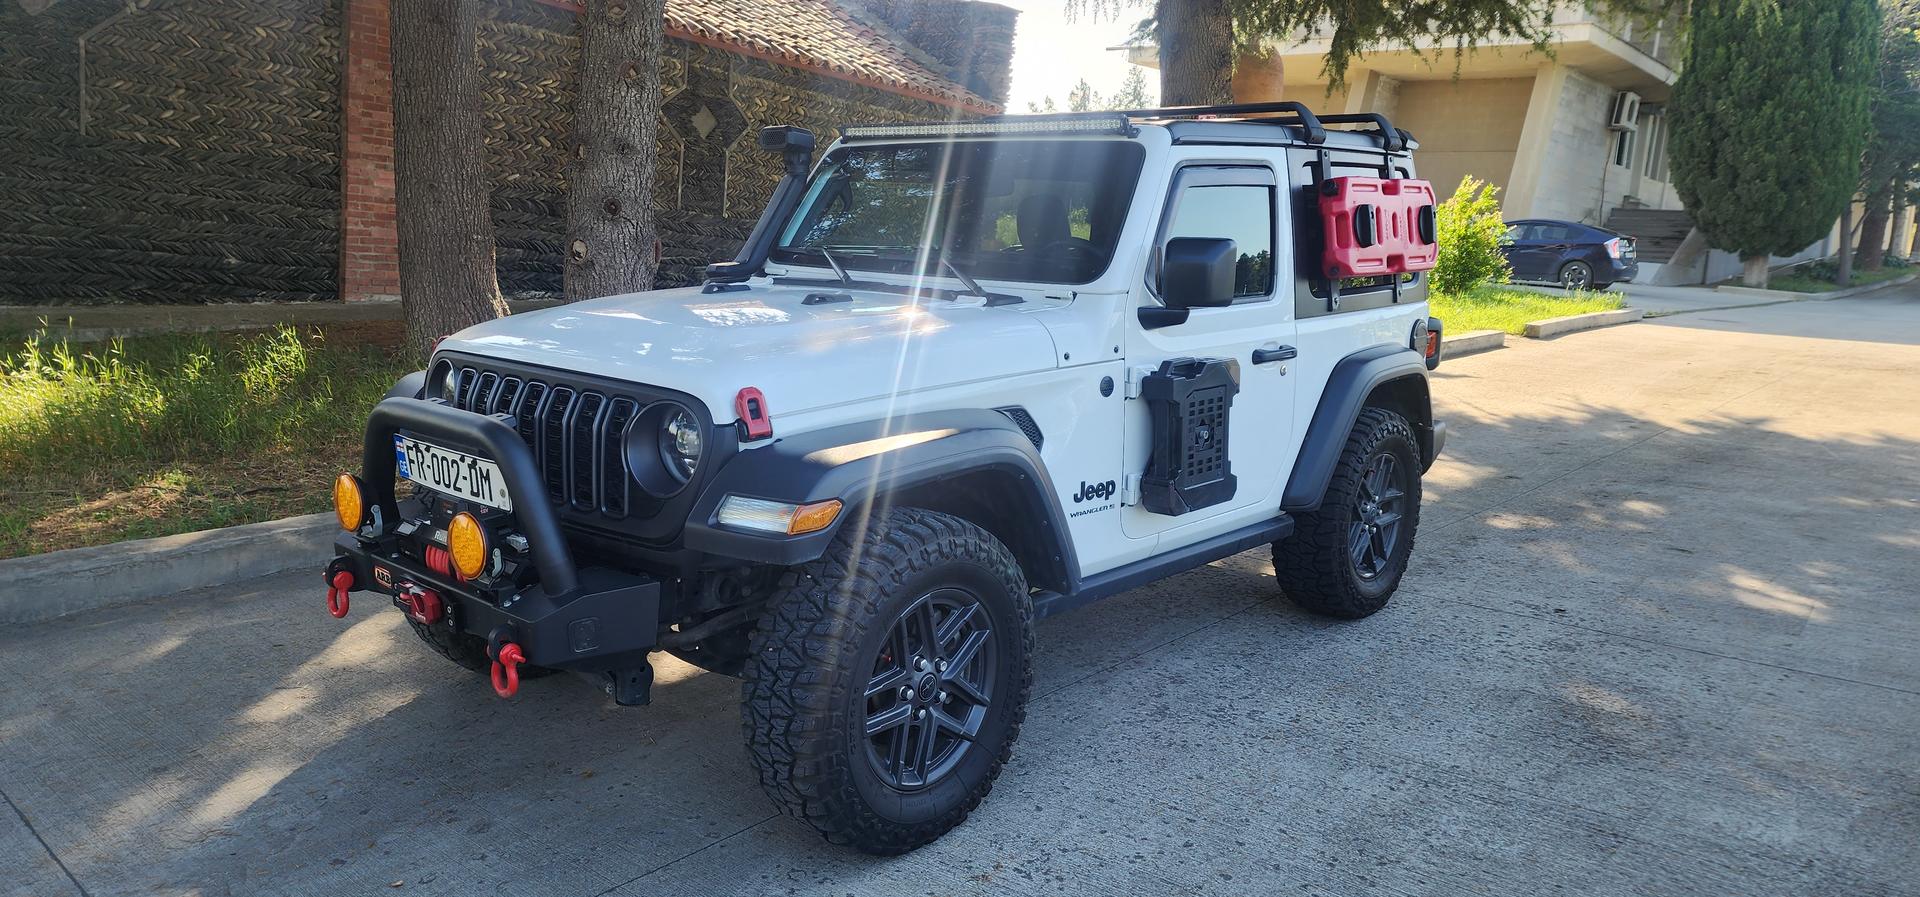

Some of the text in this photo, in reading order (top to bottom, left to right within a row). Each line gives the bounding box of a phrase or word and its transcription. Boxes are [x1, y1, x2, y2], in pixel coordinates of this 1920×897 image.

[399, 459, 408, 473] GE
[406, 444, 493, 502] FR-002-DM
[1073, 480, 1116, 503] Jeep
[1070, 506, 1108, 518] WRANGLER
[376, 569, 391, 585] ARB
